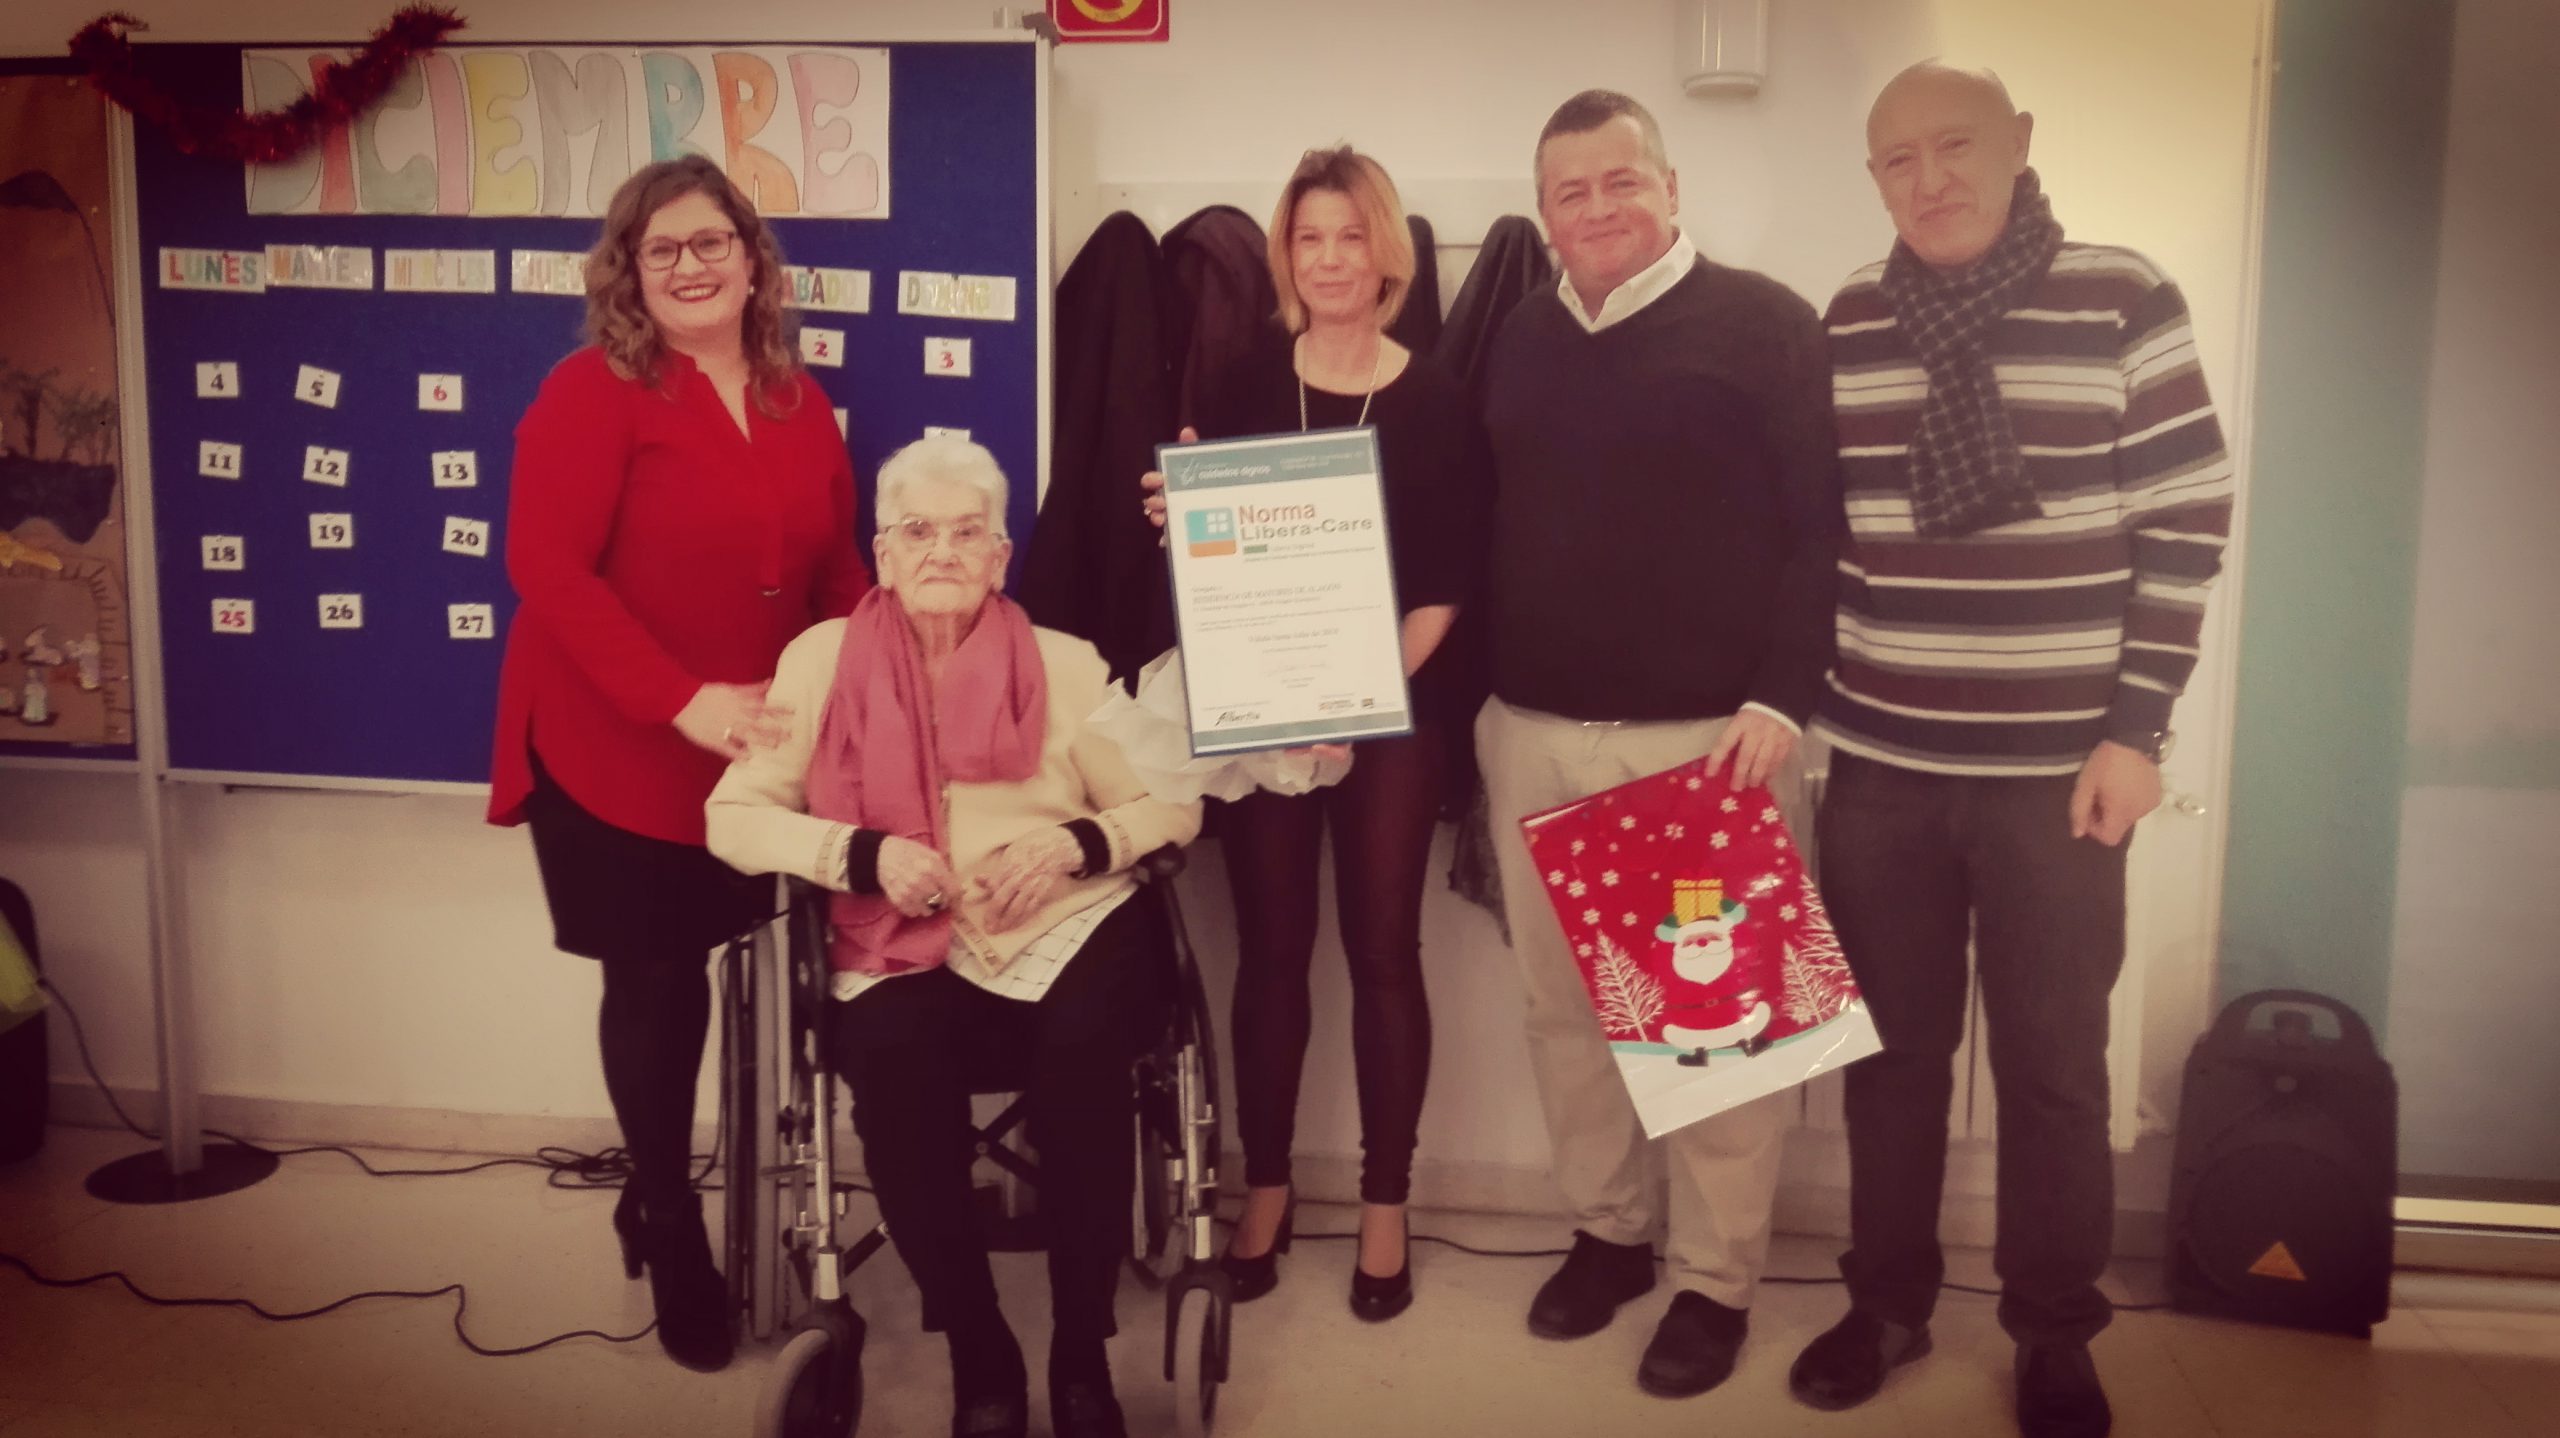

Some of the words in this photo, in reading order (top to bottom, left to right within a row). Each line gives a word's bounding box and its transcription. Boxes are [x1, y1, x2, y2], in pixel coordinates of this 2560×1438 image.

[168, 251, 258, 285] LUNES
[813, 340, 829, 358] 2
[939, 351, 955, 369] 3
[210, 373, 225, 392] 4
[309, 381, 325, 398] 5
[432, 383, 448, 402] 6
[207, 453, 233, 471] 11
[312, 459, 340, 478] 12
[441, 463, 469, 481] 13
[1238, 504, 1316, 525] Norma
[318, 525, 345, 543] 19
[451, 530, 480, 547] 20
[1240, 518, 1373, 541] Libera-Care
[208, 547, 237, 563] 18
[218, 610, 246, 627] 25
[326, 603, 354, 621] 26
[455, 615, 485, 634] 27
